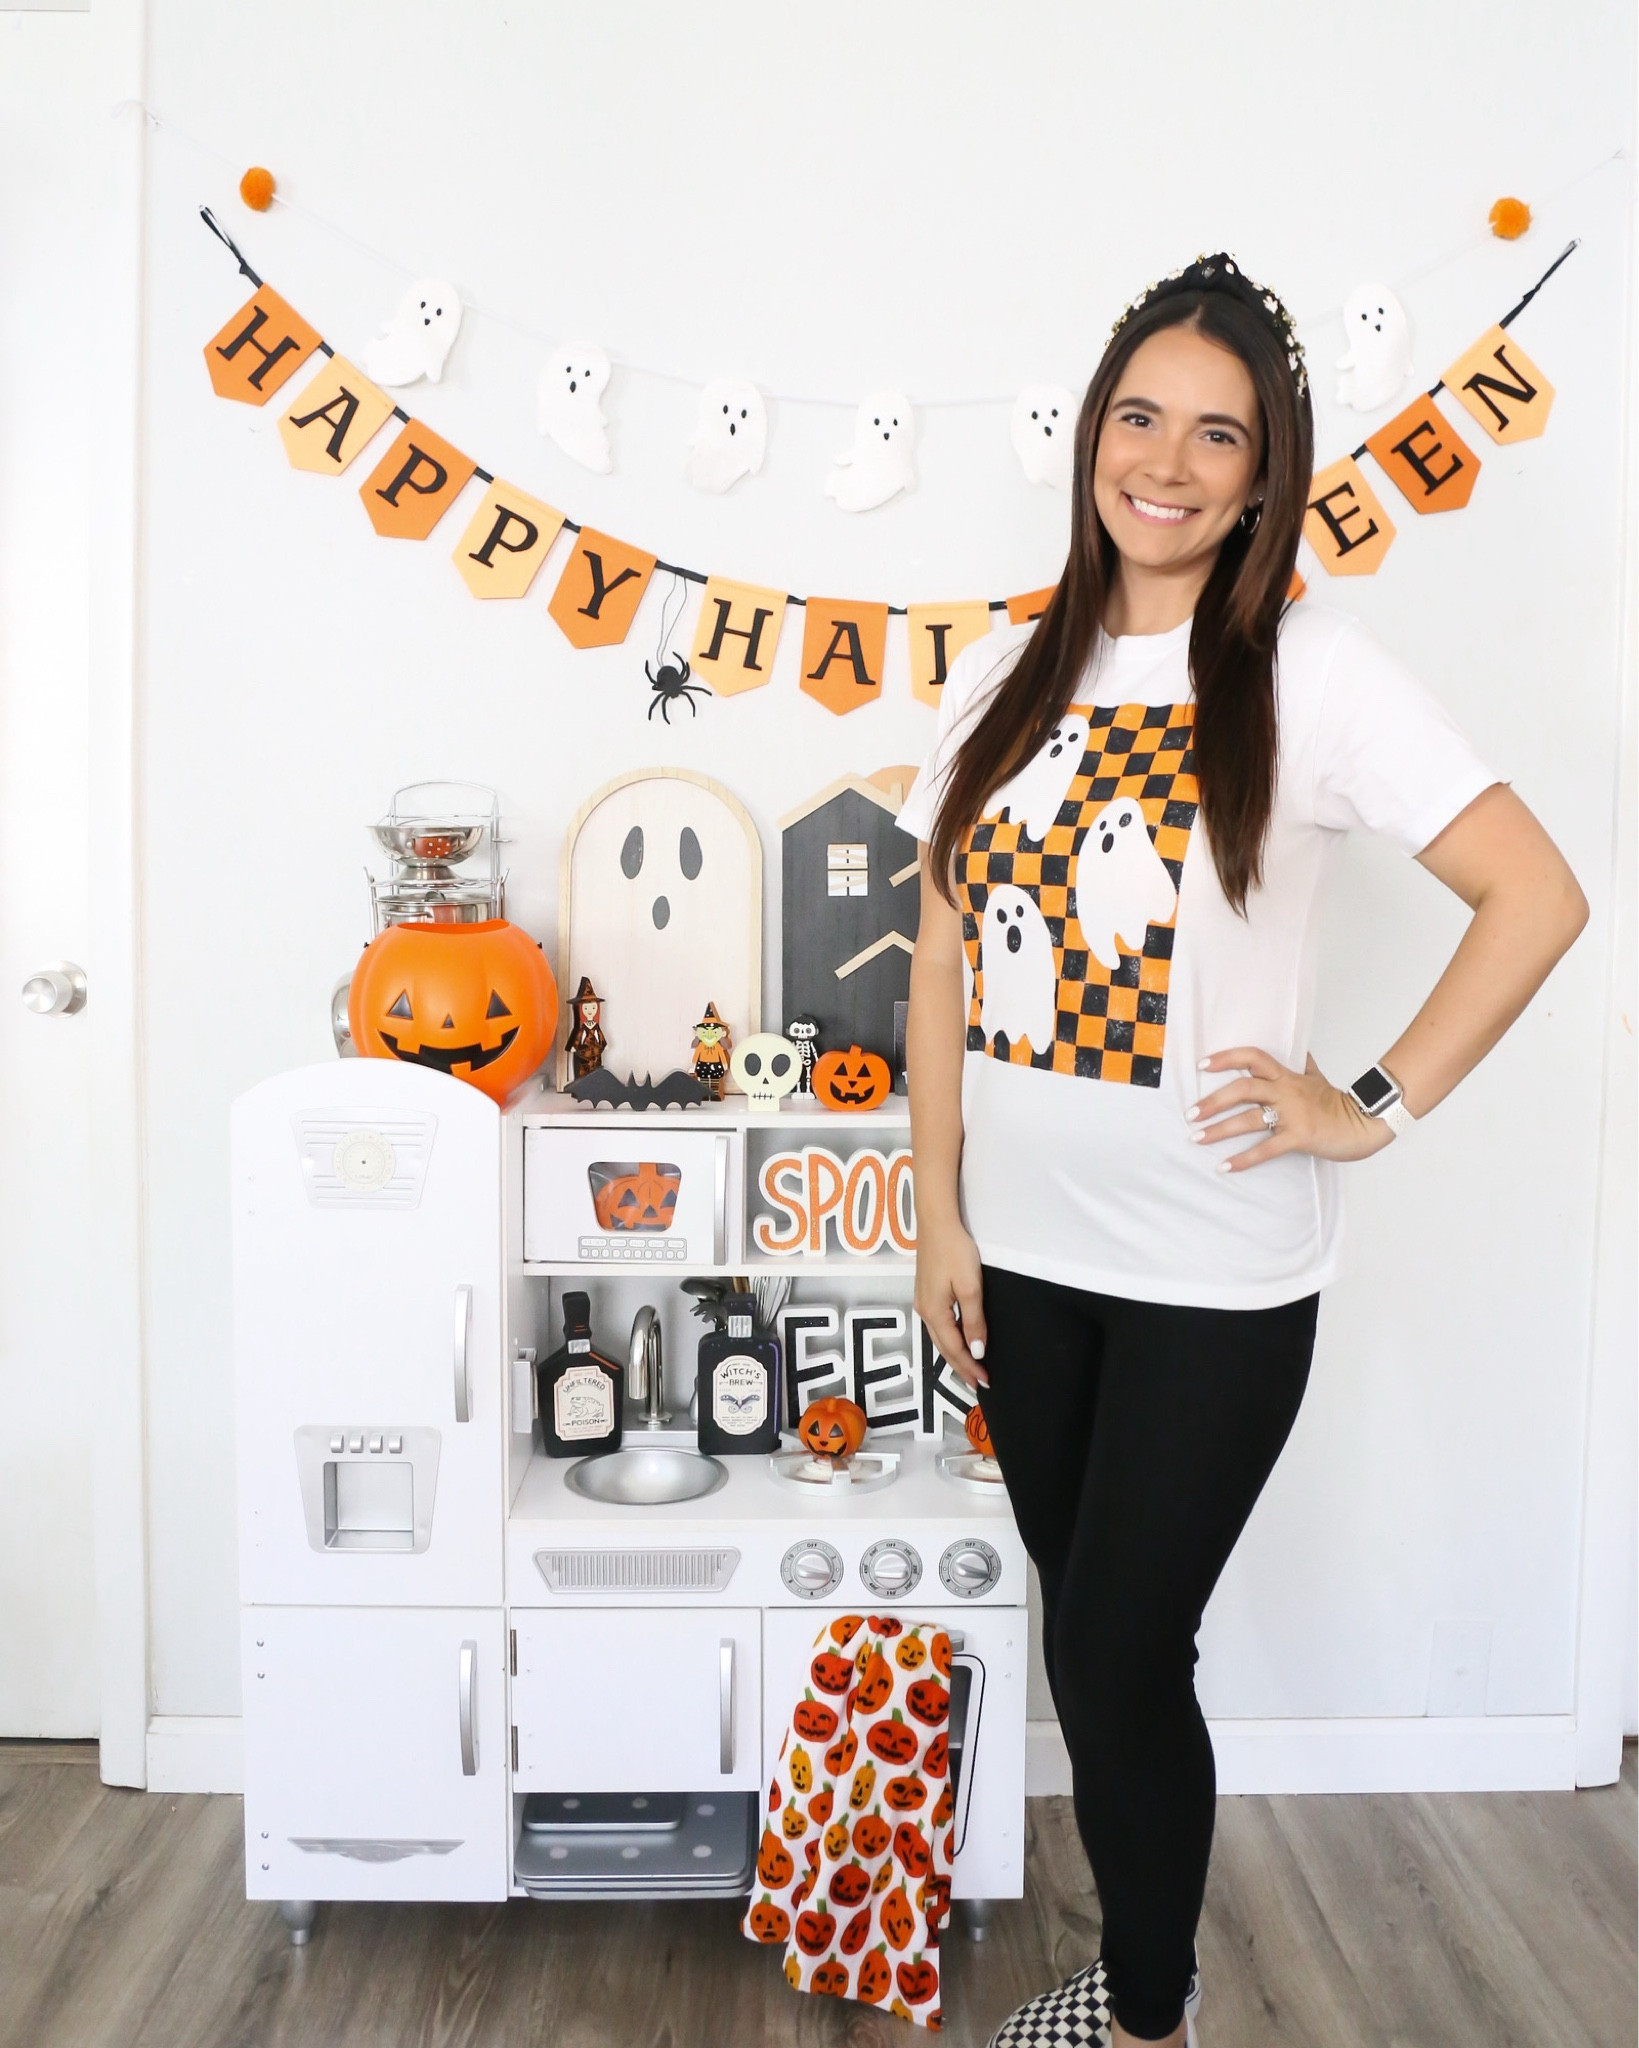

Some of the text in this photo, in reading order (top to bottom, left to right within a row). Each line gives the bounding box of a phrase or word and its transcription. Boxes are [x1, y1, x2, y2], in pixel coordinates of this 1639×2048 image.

[216, 304, 641, 620] HAPPY
[720, 1364, 761, 1379] WITCH'S
[571, 1418, 600, 1426] POISON
